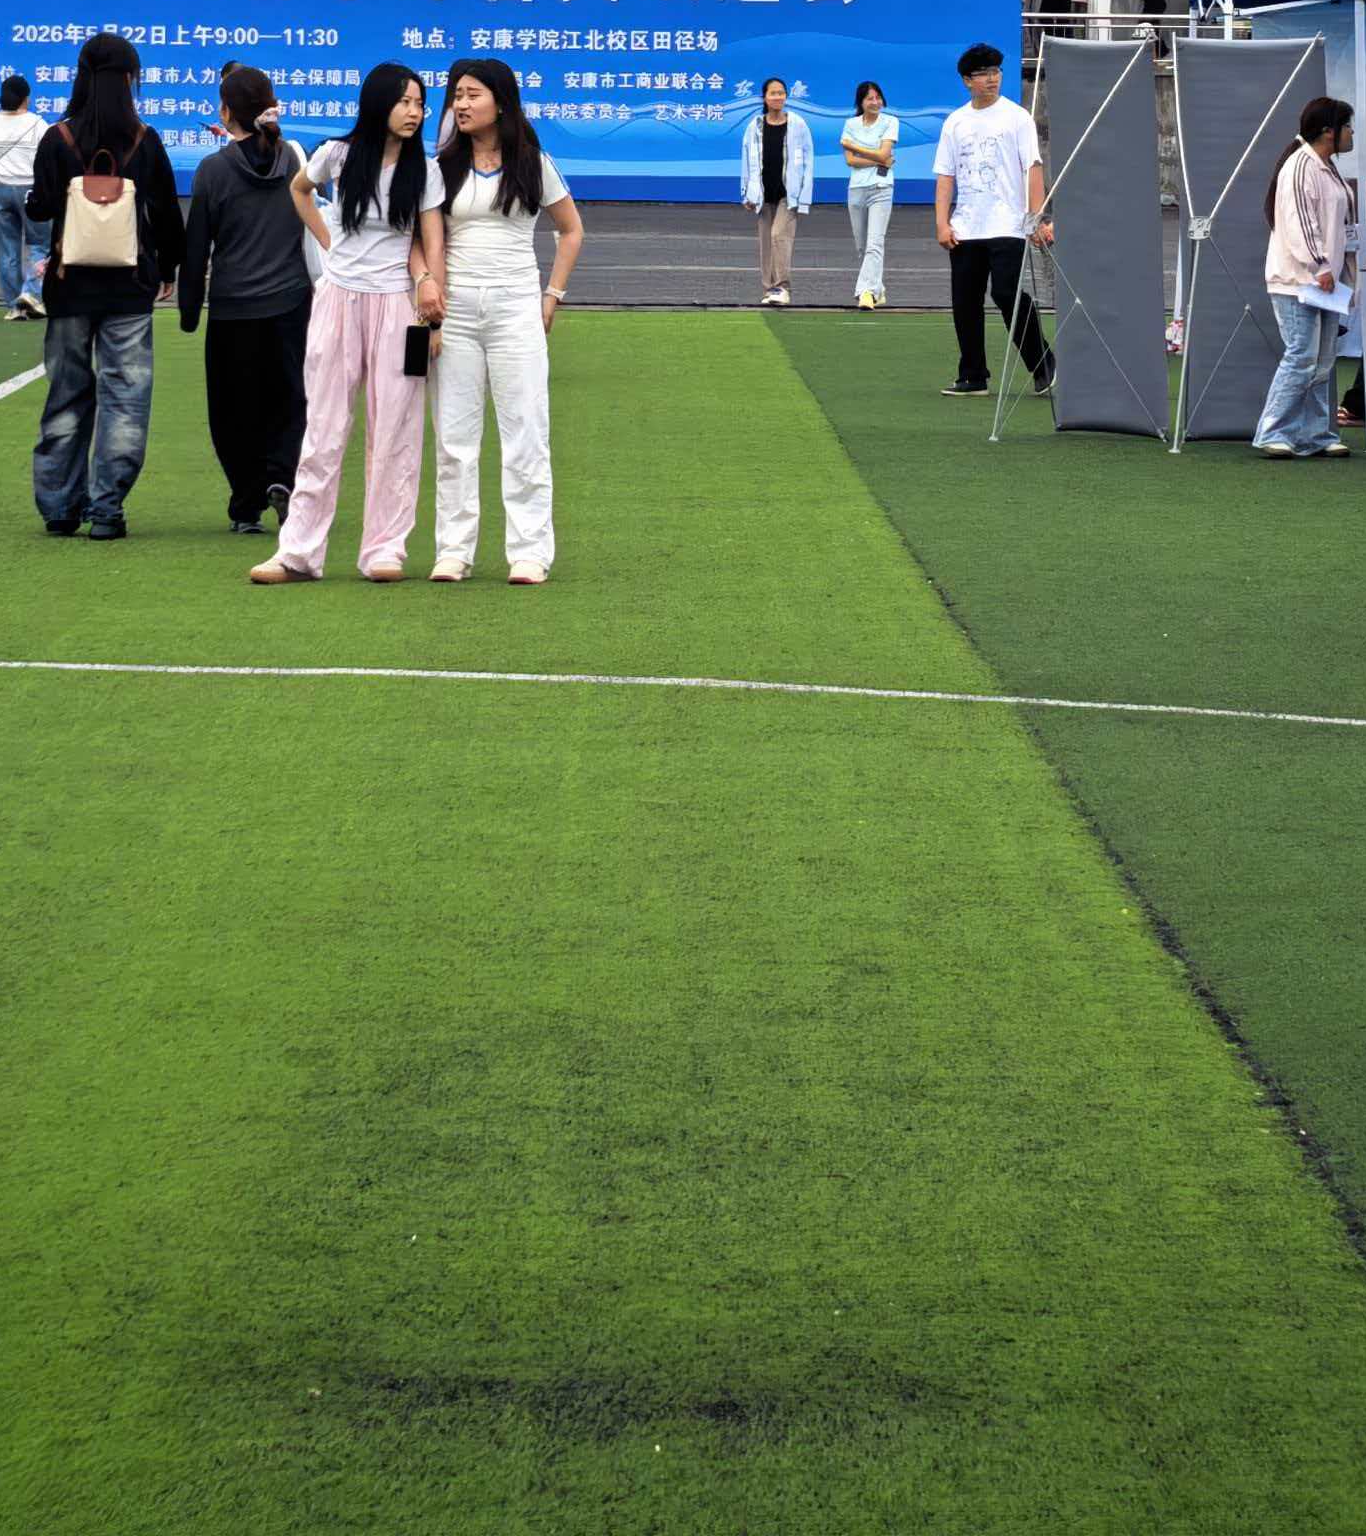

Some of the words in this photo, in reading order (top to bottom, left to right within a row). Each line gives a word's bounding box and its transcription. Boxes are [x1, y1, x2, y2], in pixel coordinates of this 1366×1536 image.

[564, 72, 724, 90] 安康市工商业联合会
[653, 103, 724, 121] 艺术学院
